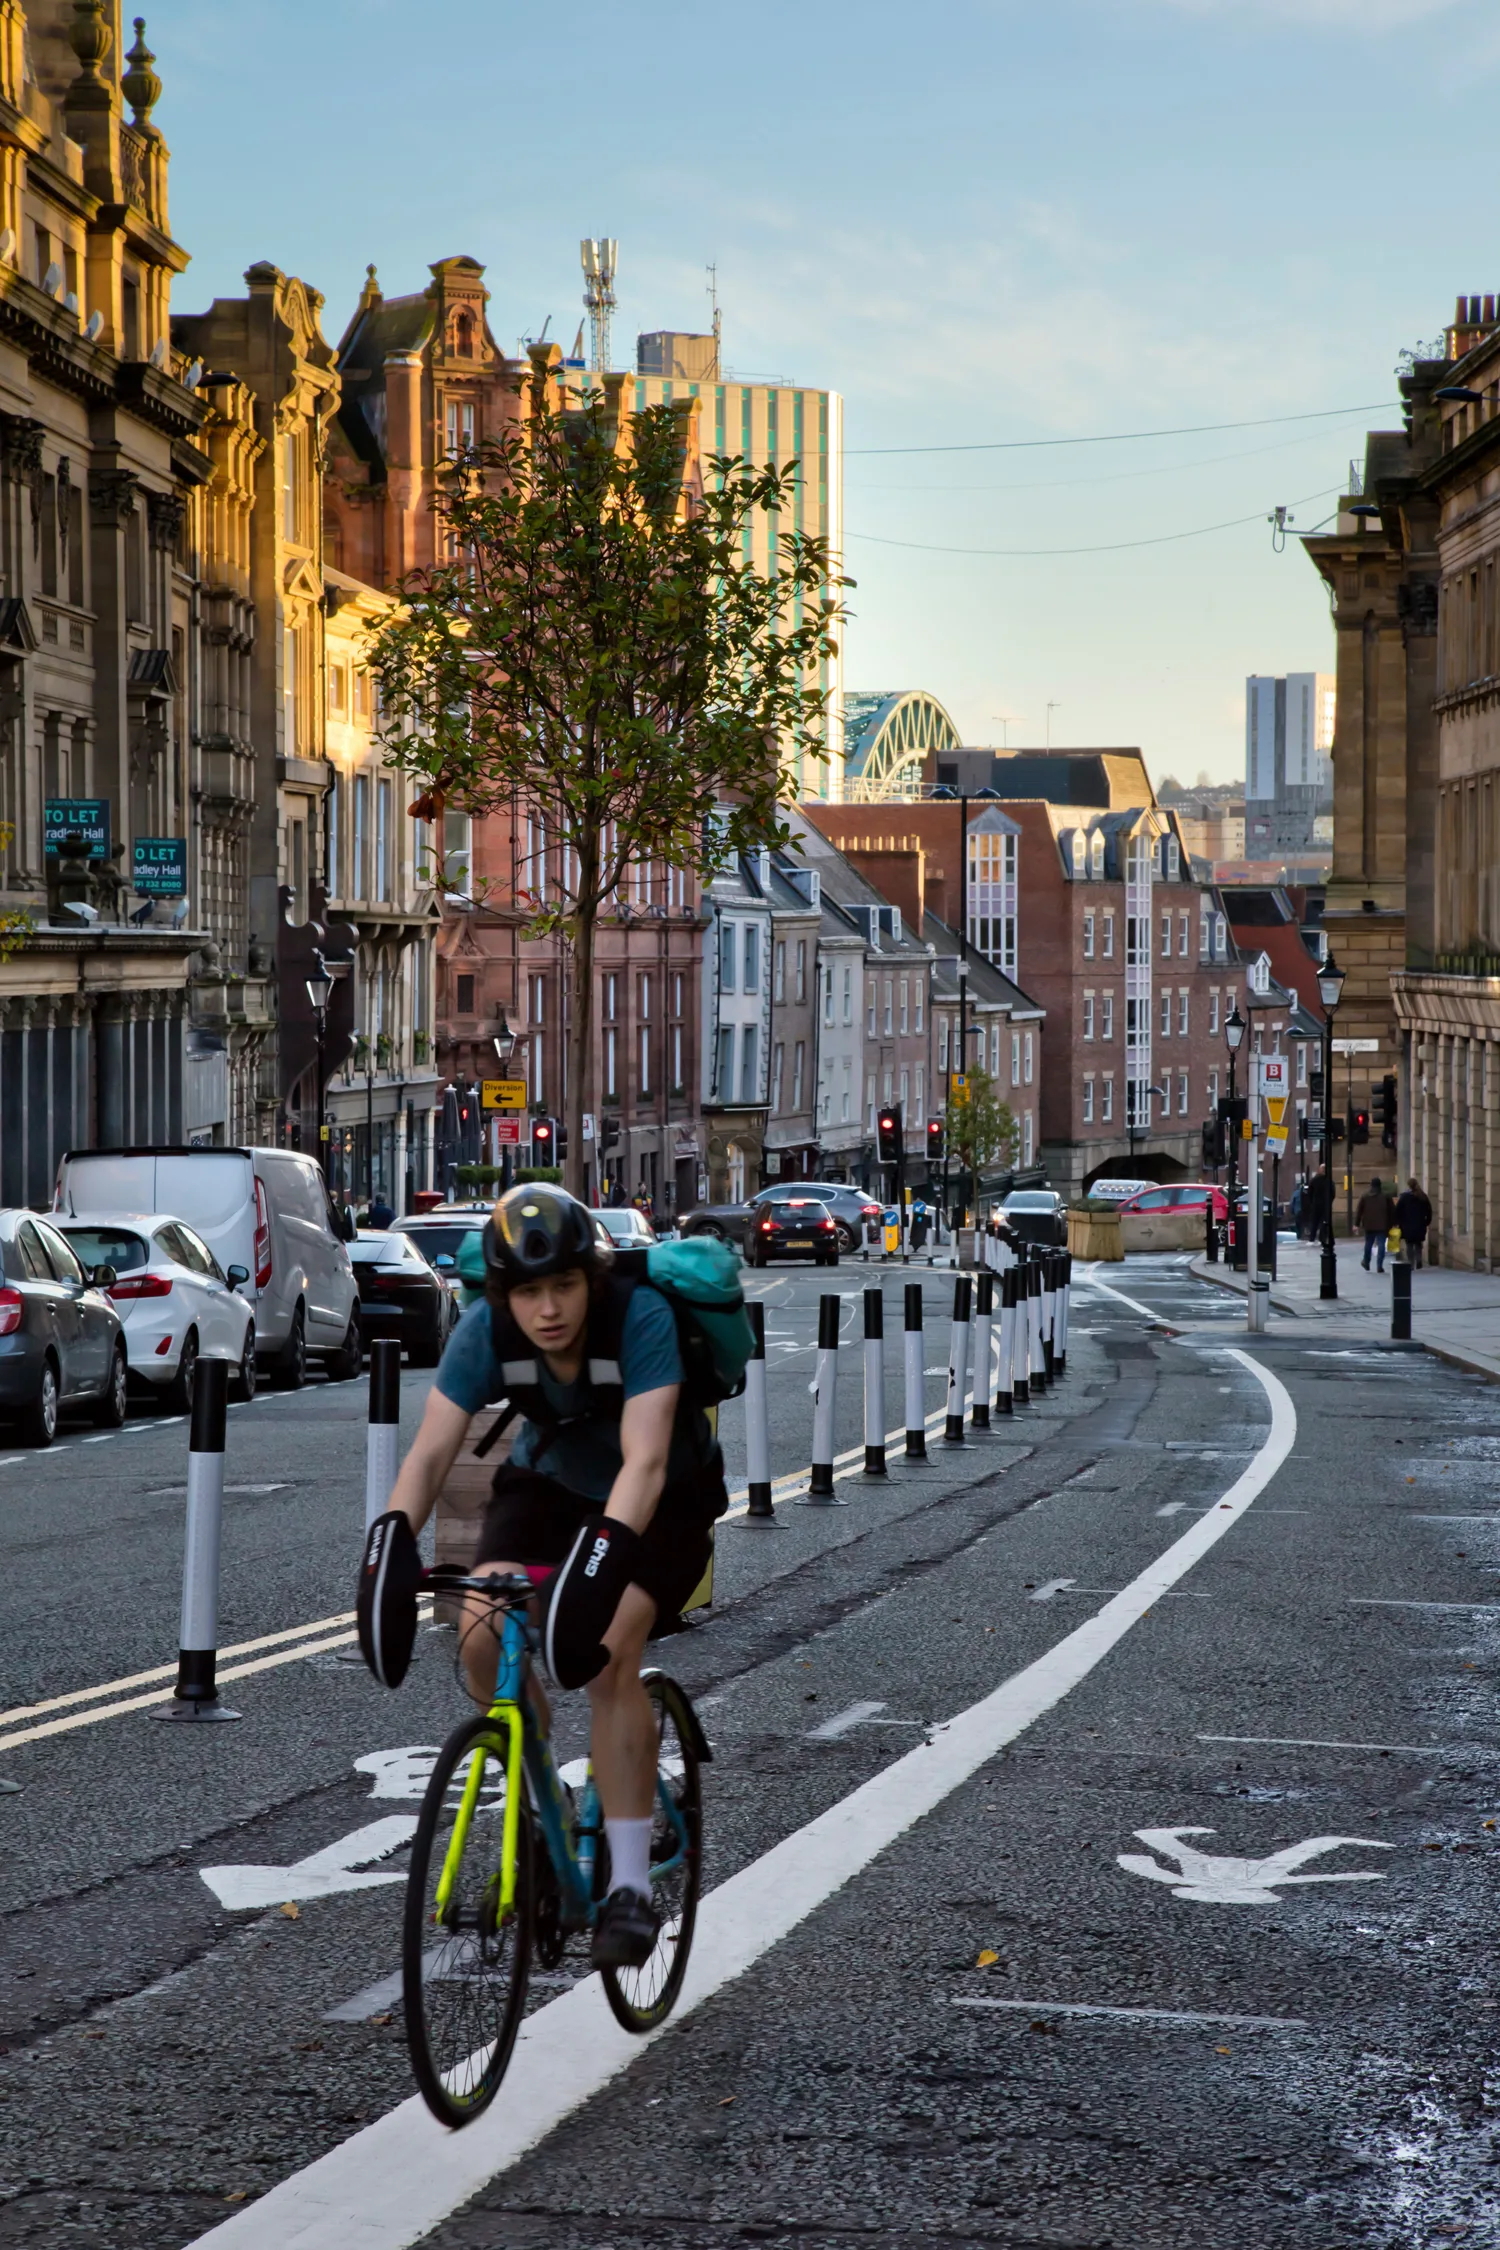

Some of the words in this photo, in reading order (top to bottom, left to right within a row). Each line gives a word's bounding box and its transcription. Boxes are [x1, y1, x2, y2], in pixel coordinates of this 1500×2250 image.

[45, 810, 63, 823] TO
[69, 810, 99, 823] LET
[83, 828, 104, 839] Hall
[150, 848, 176, 861] LET
[162, 865, 181, 875] Hall
[1269, 1065, 1278, 1076] B
[484, 1083, 523, 1091] Diversion
